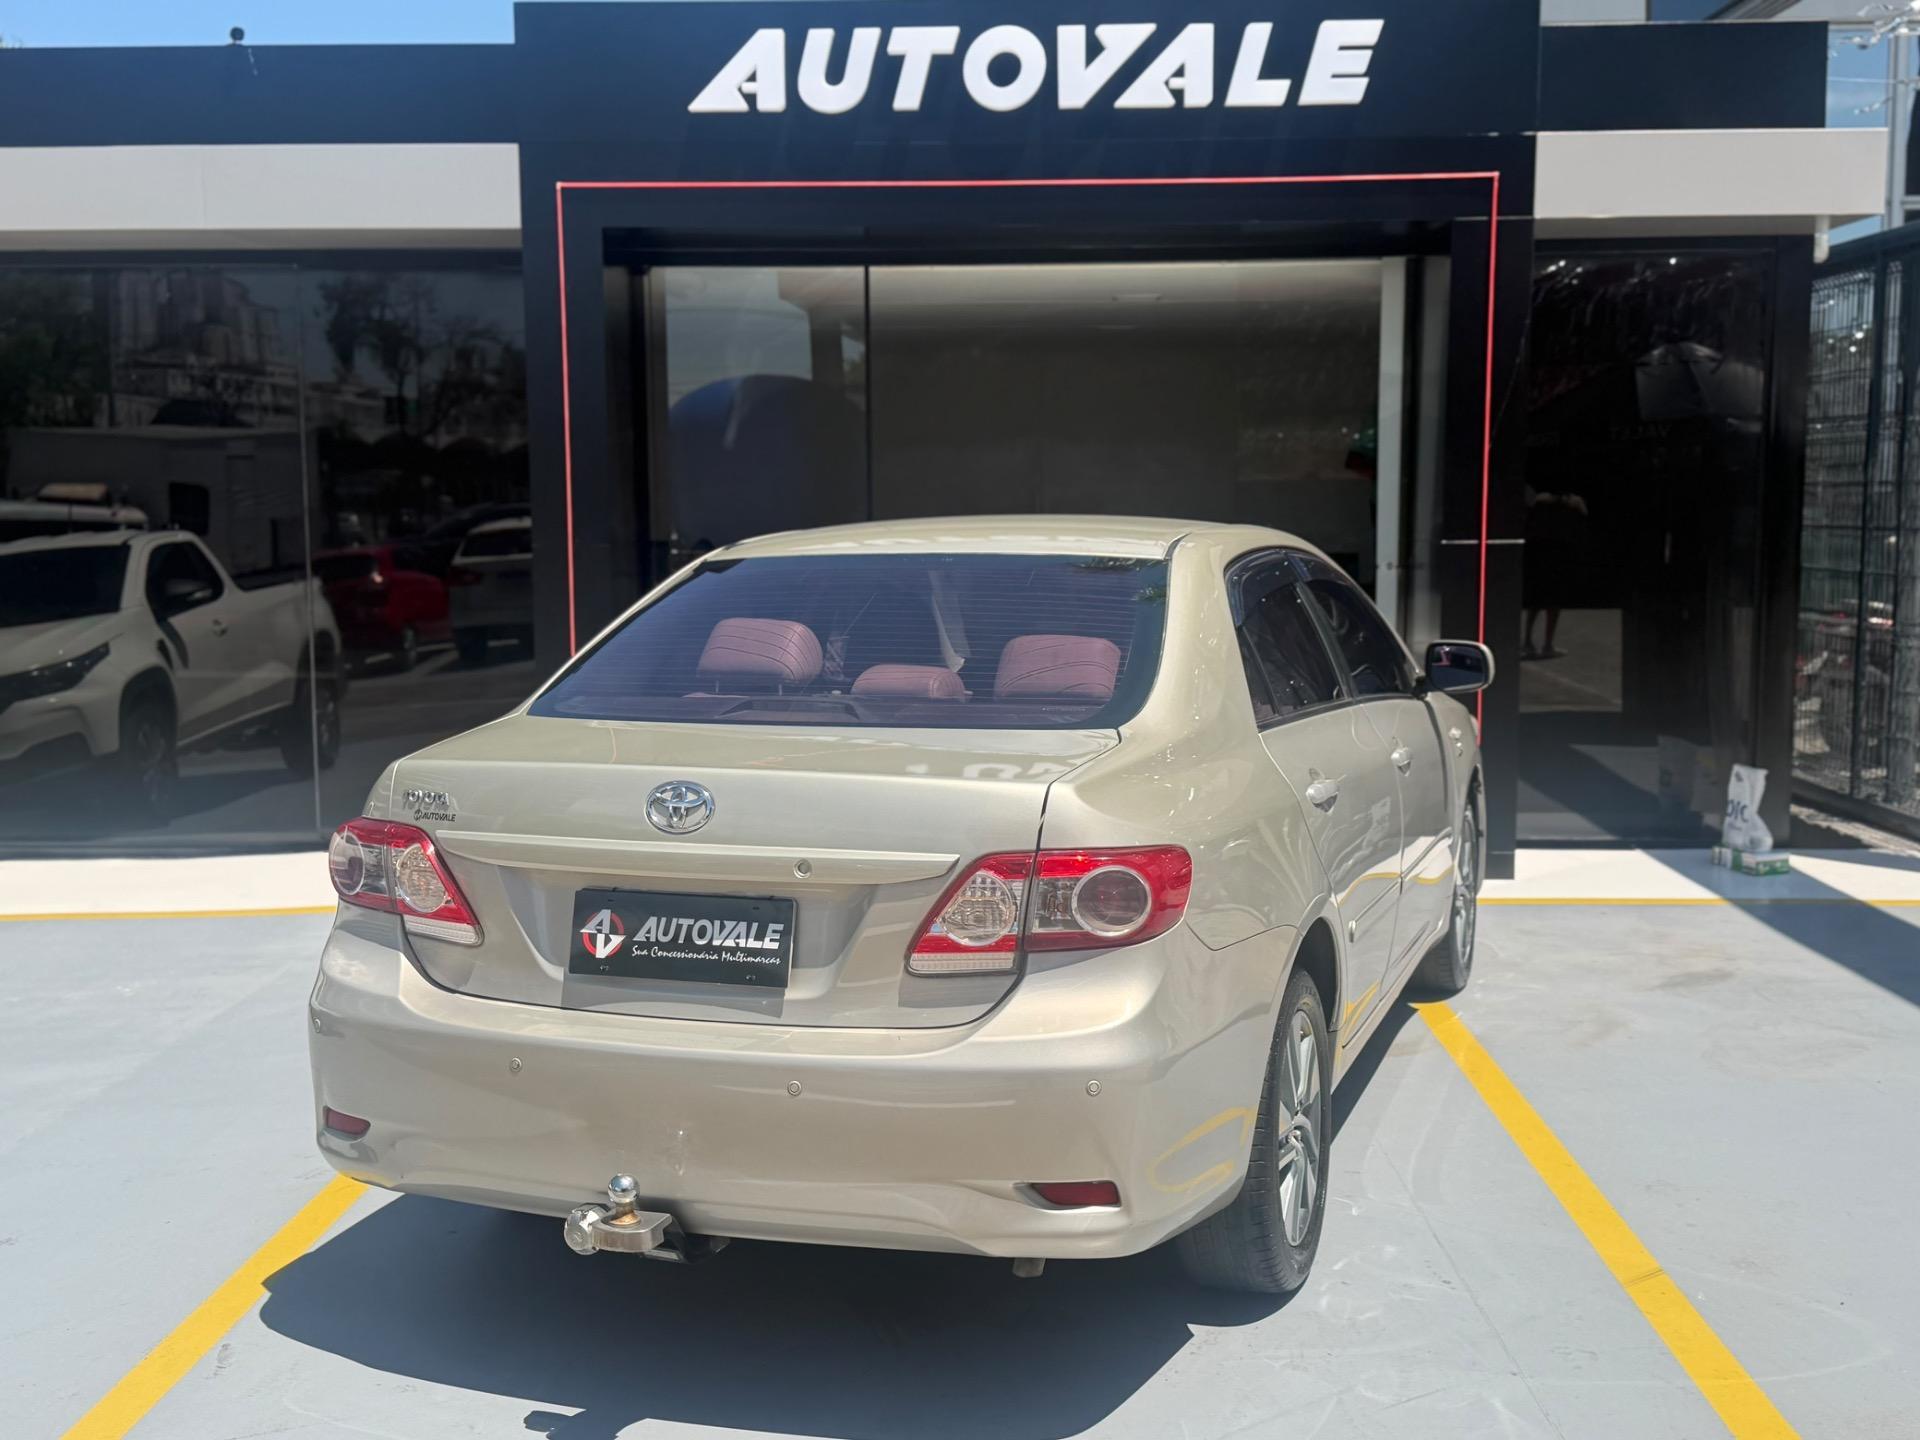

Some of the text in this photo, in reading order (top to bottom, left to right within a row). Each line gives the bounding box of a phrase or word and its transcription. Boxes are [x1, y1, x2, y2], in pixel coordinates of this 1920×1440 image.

[687, 18, 1385, 114] AUTOVALE
[421, 811, 456, 822] AUTOVALE
[632, 916, 785, 950] AUTOVALE
[631, 944, 782, 965] Sua Concessionária Multimarcas
